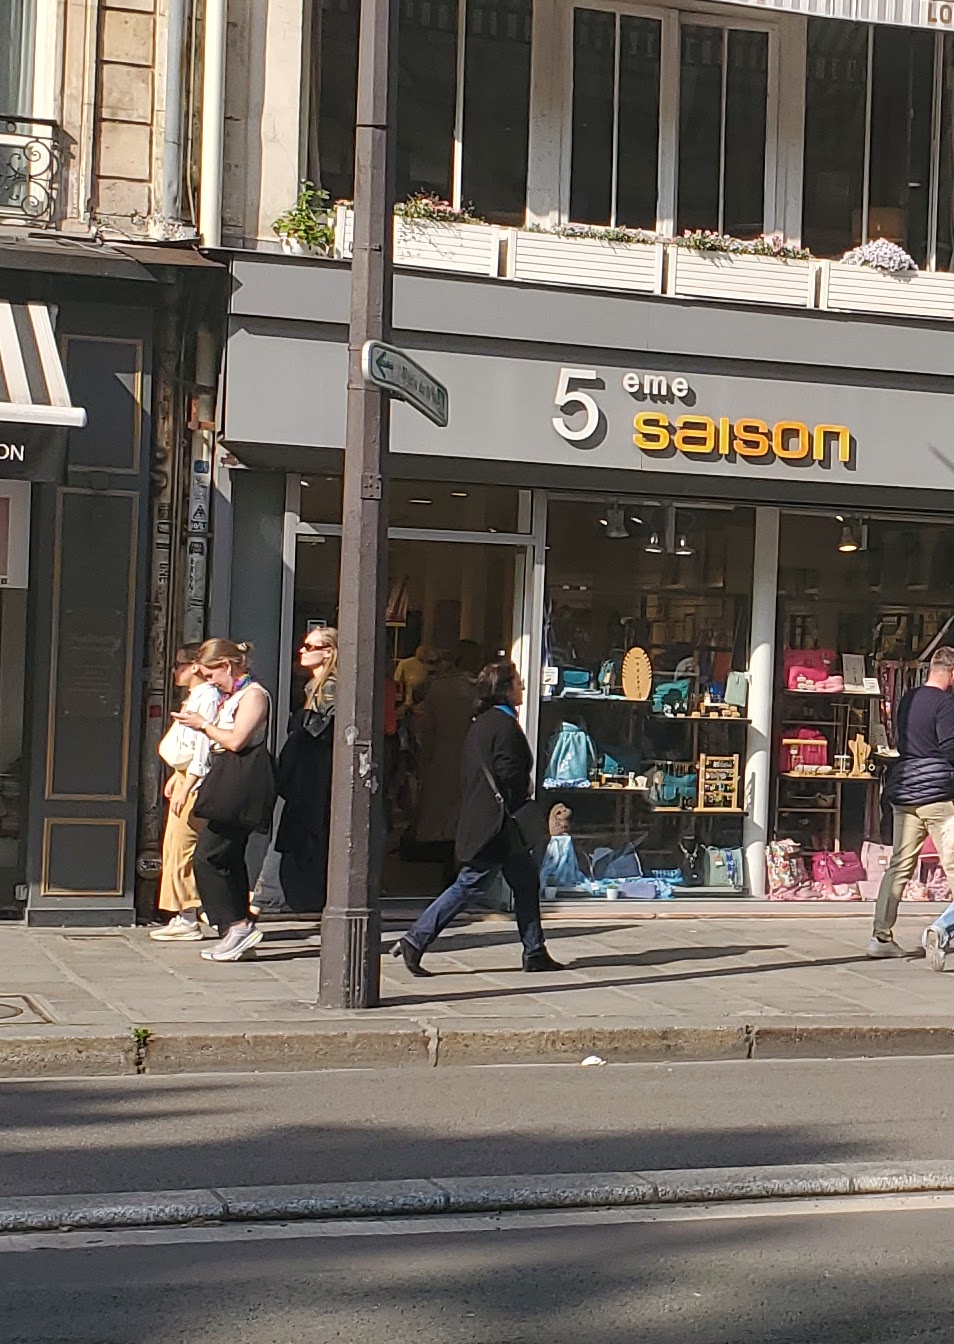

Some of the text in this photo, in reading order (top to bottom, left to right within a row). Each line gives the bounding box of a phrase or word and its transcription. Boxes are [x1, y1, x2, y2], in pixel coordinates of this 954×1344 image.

[552, 367, 690, 442] 5 eme
[632, 411, 850, 462] saison
